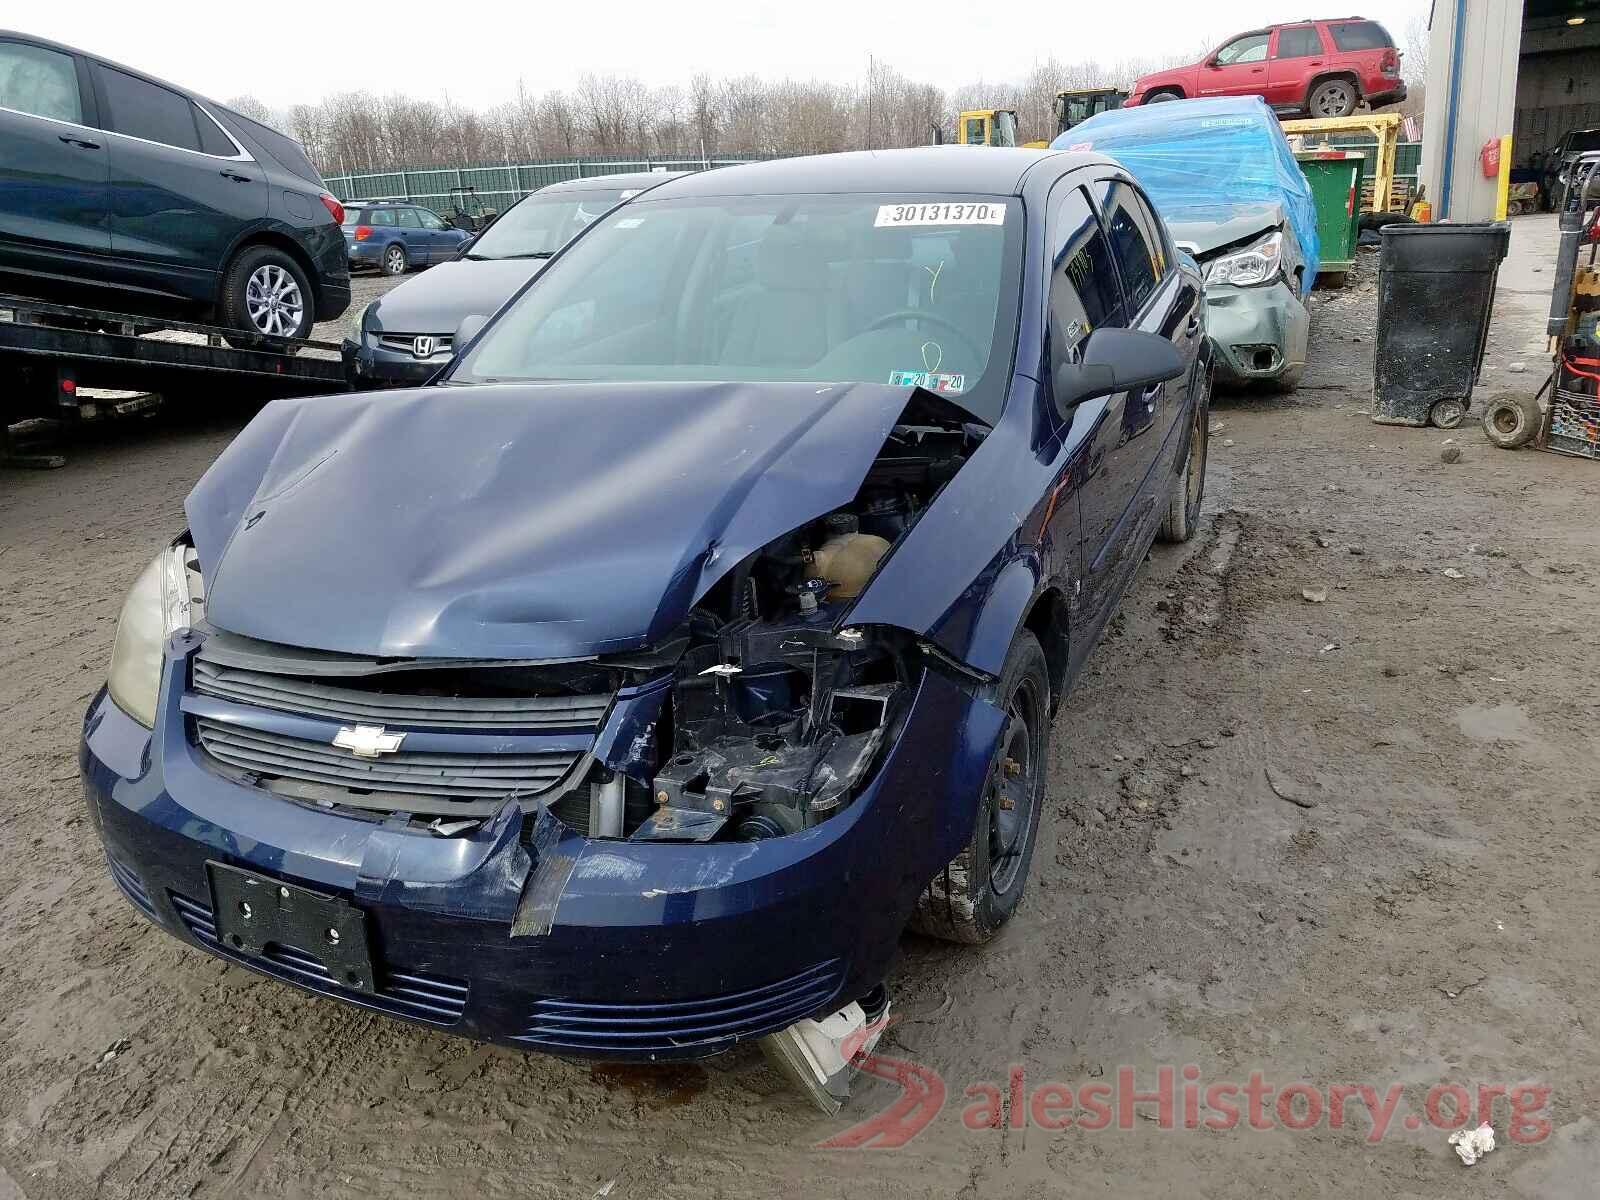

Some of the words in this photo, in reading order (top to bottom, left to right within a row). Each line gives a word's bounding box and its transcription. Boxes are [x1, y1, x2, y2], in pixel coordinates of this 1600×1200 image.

[892, 205, 988, 221] 30131370
[914, 373, 926, 386] 20
[951, 375, 962, 388] 20
